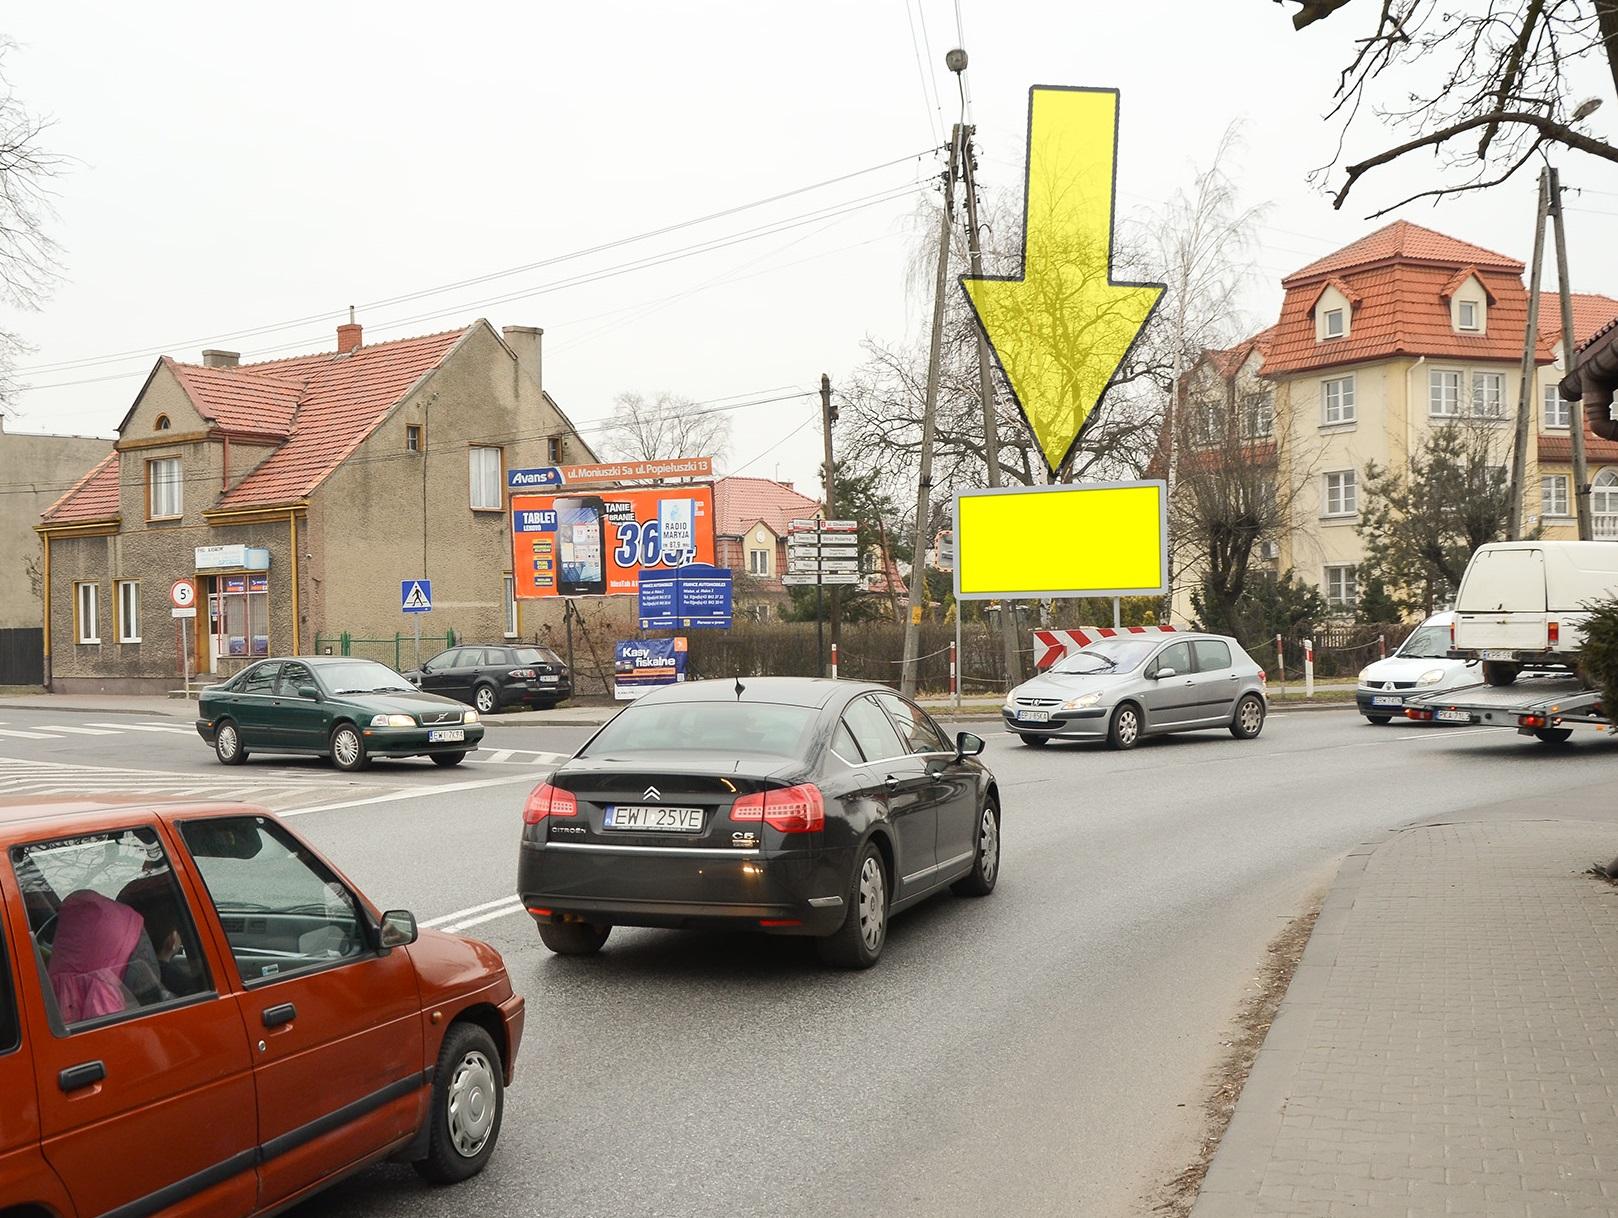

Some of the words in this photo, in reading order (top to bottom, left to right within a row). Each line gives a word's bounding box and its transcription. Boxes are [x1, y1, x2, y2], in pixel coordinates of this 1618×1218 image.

[568, 470, 577, 479] ul.
[579, 466, 620, 478] Moniuszki
[622, 467, 633, 475] 5a
[635, 466, 646, 475] ul.
[646, 461, 697, 475] Popiełuszki
[698, 461, 708, 471] 13
[512, 472, 547, 484] Avans
[604, 503, 631, 512] TANIE
[522, 511, 556, 524] TABLET
[665, 522, 687, 530] RADIO
[663, 531, 689, 539] MARYJA
[180, 588, 187, 600] 5
[623, 648, 649, 658] Kasy
[636, 656, 676, 667] fiskalne
[614, 808, 648, 825] EWI
[656, 809, 701, 827] 25VE
[732, 832, 755, 840] C5
